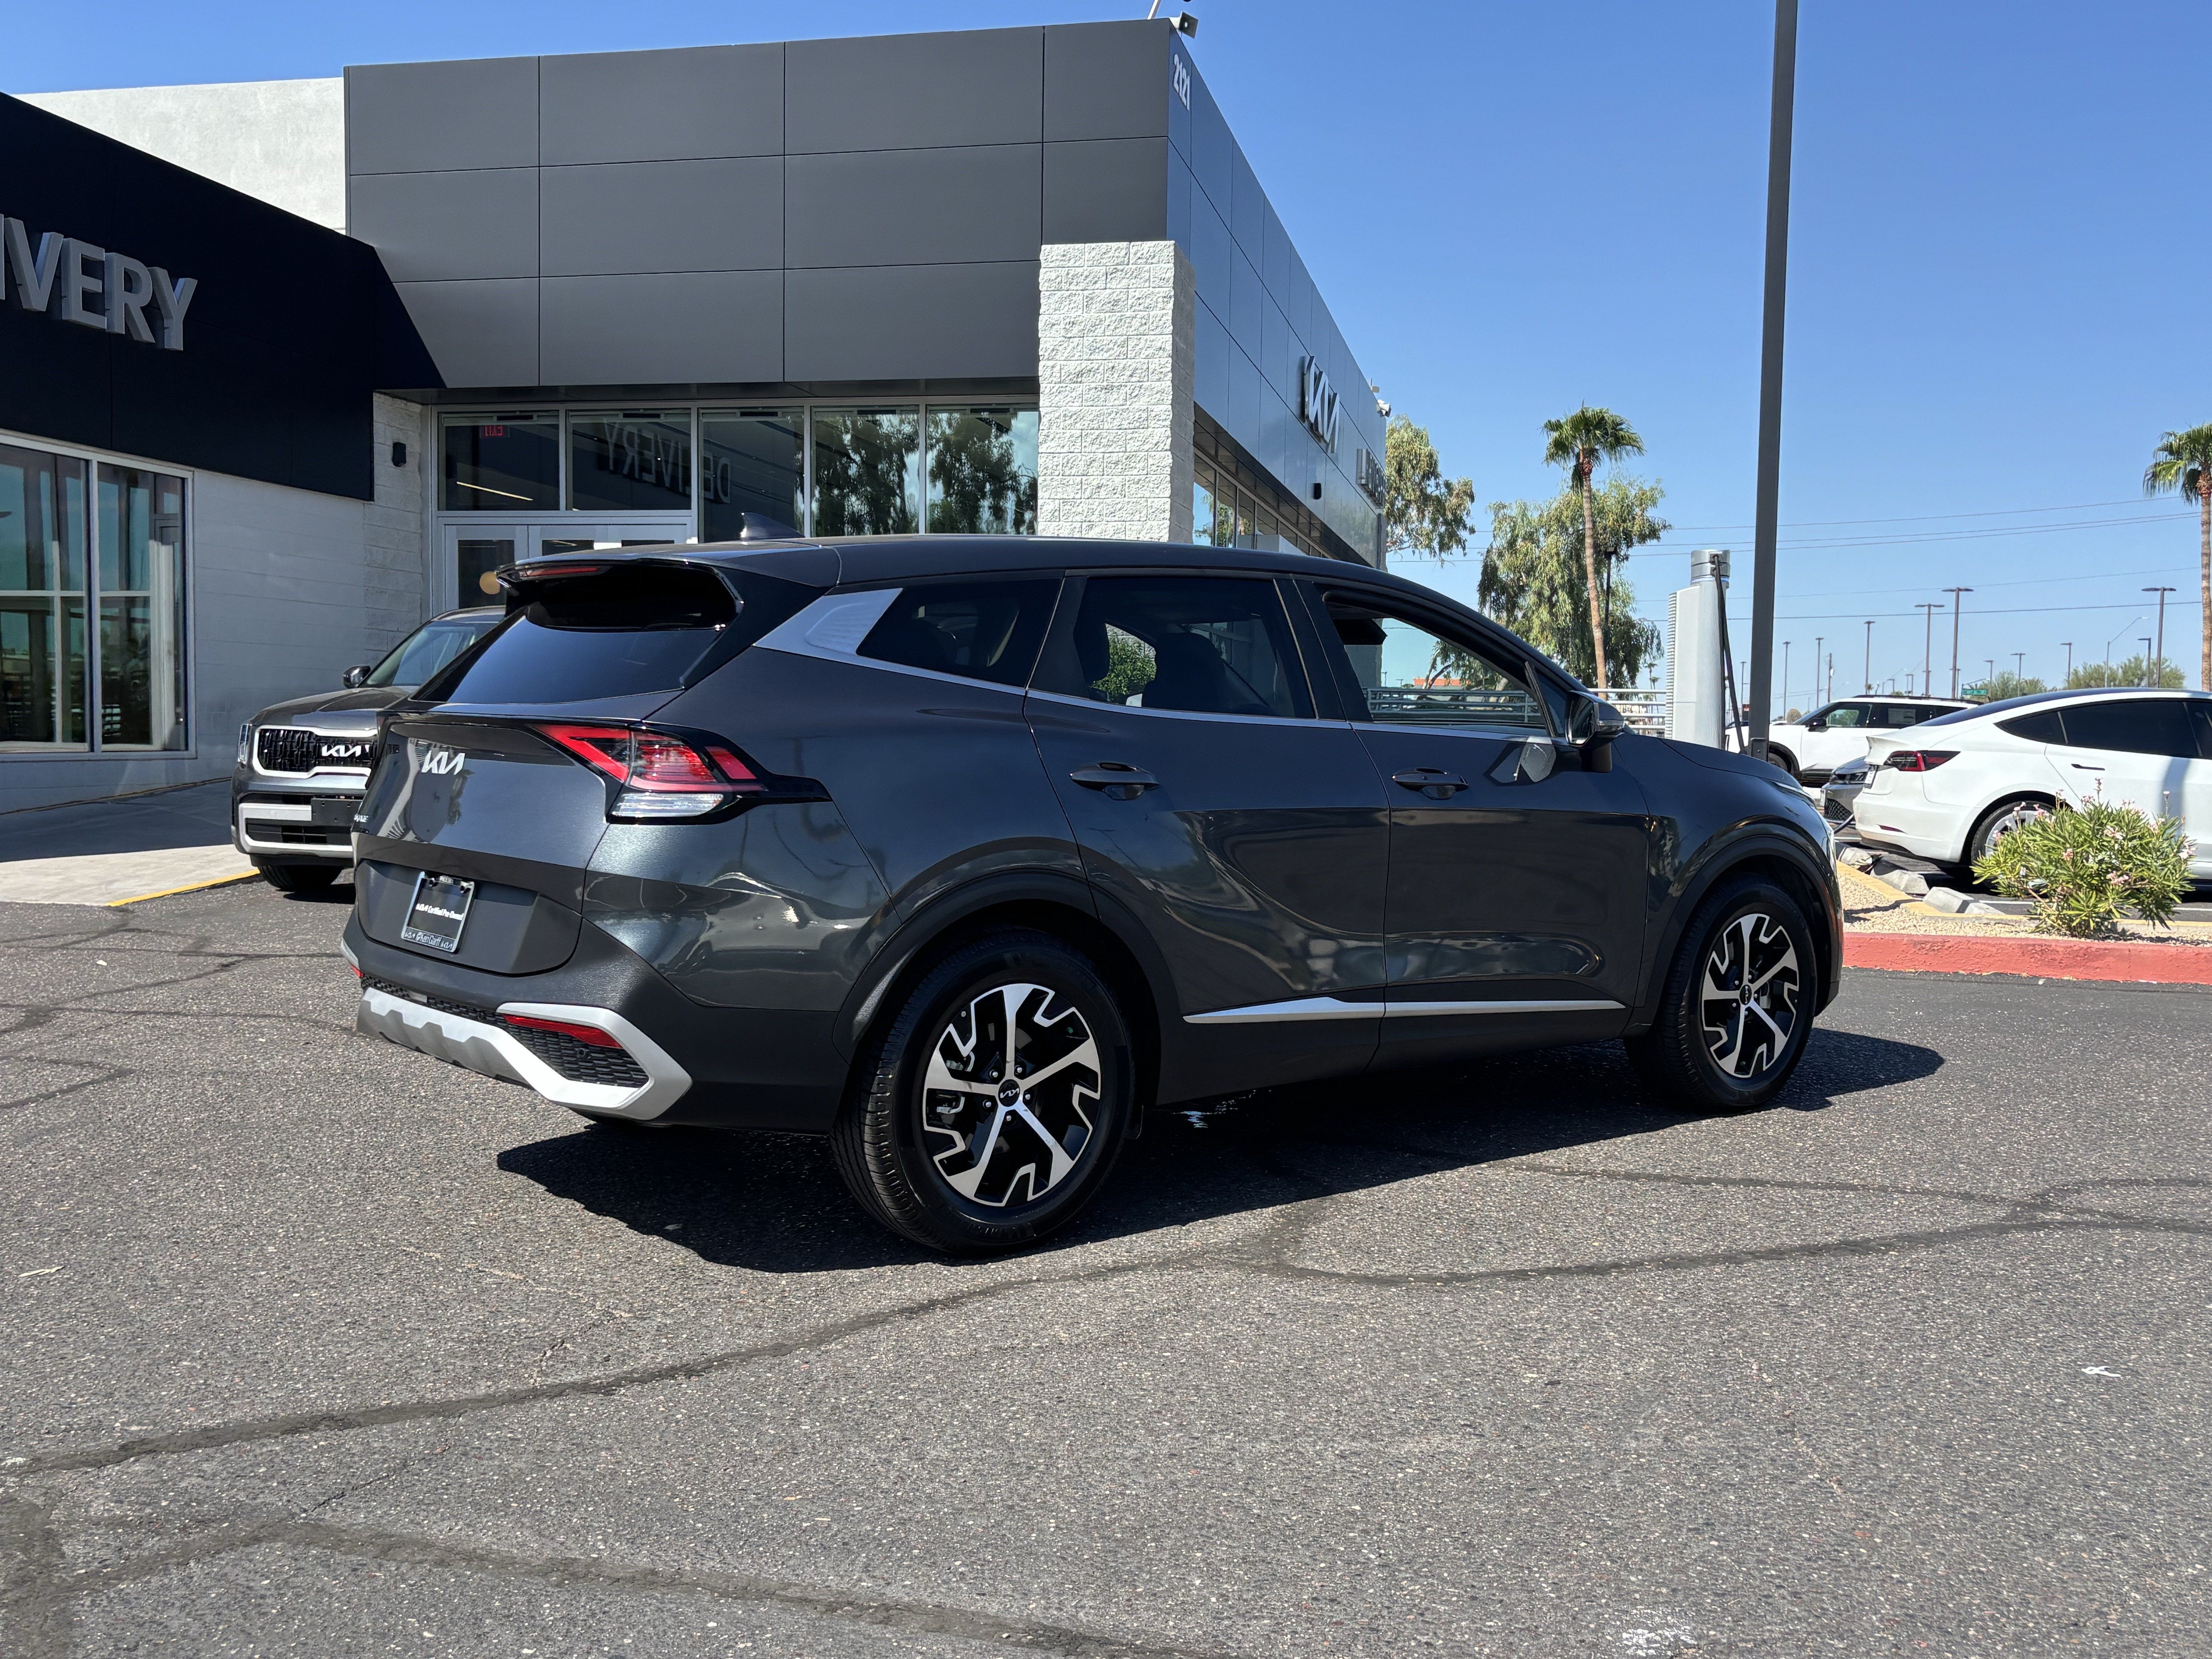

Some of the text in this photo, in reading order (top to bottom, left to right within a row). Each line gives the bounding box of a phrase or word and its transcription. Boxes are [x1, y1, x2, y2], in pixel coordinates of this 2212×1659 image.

[1173, 54, 1190, 112] 2121
[1304, 356, 1340, 454] KIA
[321, 745, 362, 757] KIA
[421, 750, 465, 775] KIA
